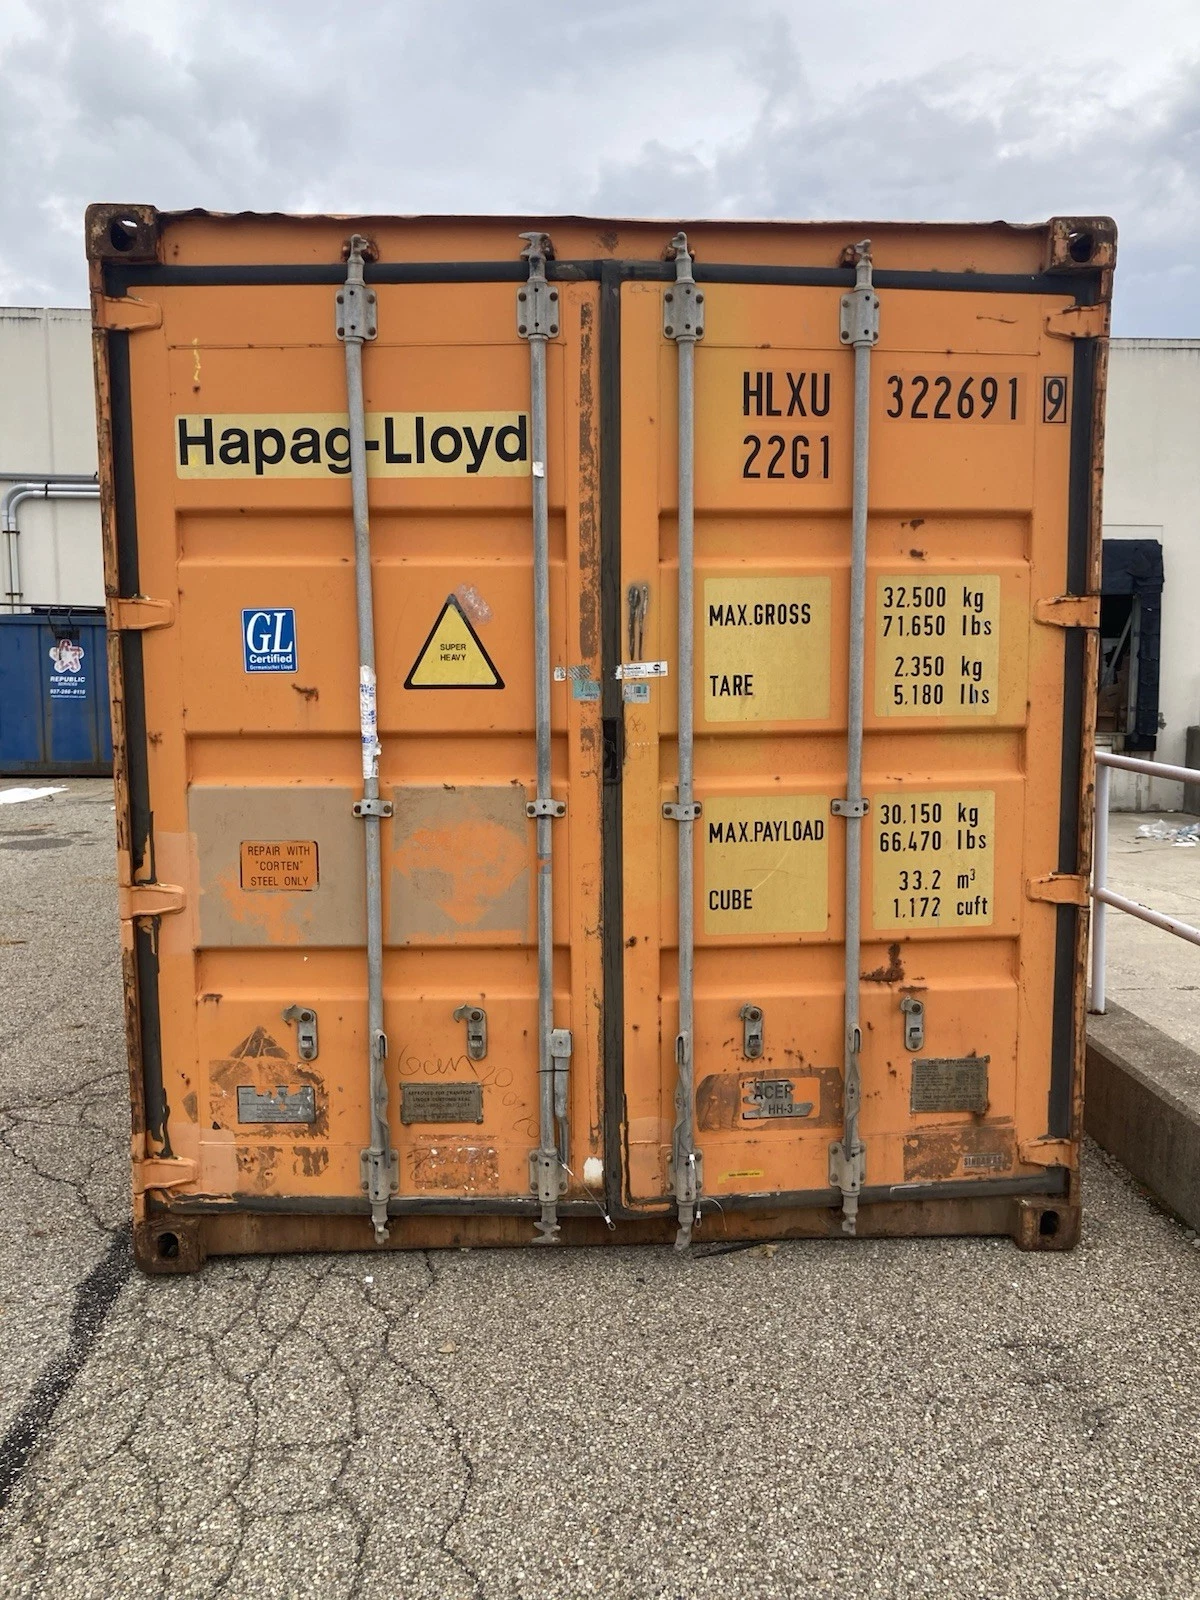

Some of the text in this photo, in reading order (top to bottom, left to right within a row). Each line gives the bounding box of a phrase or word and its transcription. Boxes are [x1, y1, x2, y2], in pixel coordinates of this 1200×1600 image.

[743, 371, 1064, 421] HLXU 322691 9
[178, 415, 527, 475] Hapag-Lloyd
[743, 434, 829, 479] 22G1
[963, 586, 983, 613] kg
[709, 603, 811, 627] MAX.GROSS
[962, 614, 992, 636] lbs
[246, 611, 293, 654] GL
[249, 653, 293, 664] Certified
[440, 643, 467, 651] SUPER
[440, 653, 467, 661] HEAVY
[961, 655, 982, 682] kg
[709, 674, 754, 697] TARE
[957, 802, 979, 828] kg
[709, 820, 824, 843] MAX.PAYLOAD
[957, 829, 987, 850] lbs
[247, 845, 310, 856] REPAIR WITH
[250, 876, 309, 887] STEEL ONLY
[899, 869, 942, 891] 33.2
[709, 888, 753, 911] CUBE
[956, 895, 988, 916] cuft
[768, 1103, 793, 1115] HH-3
